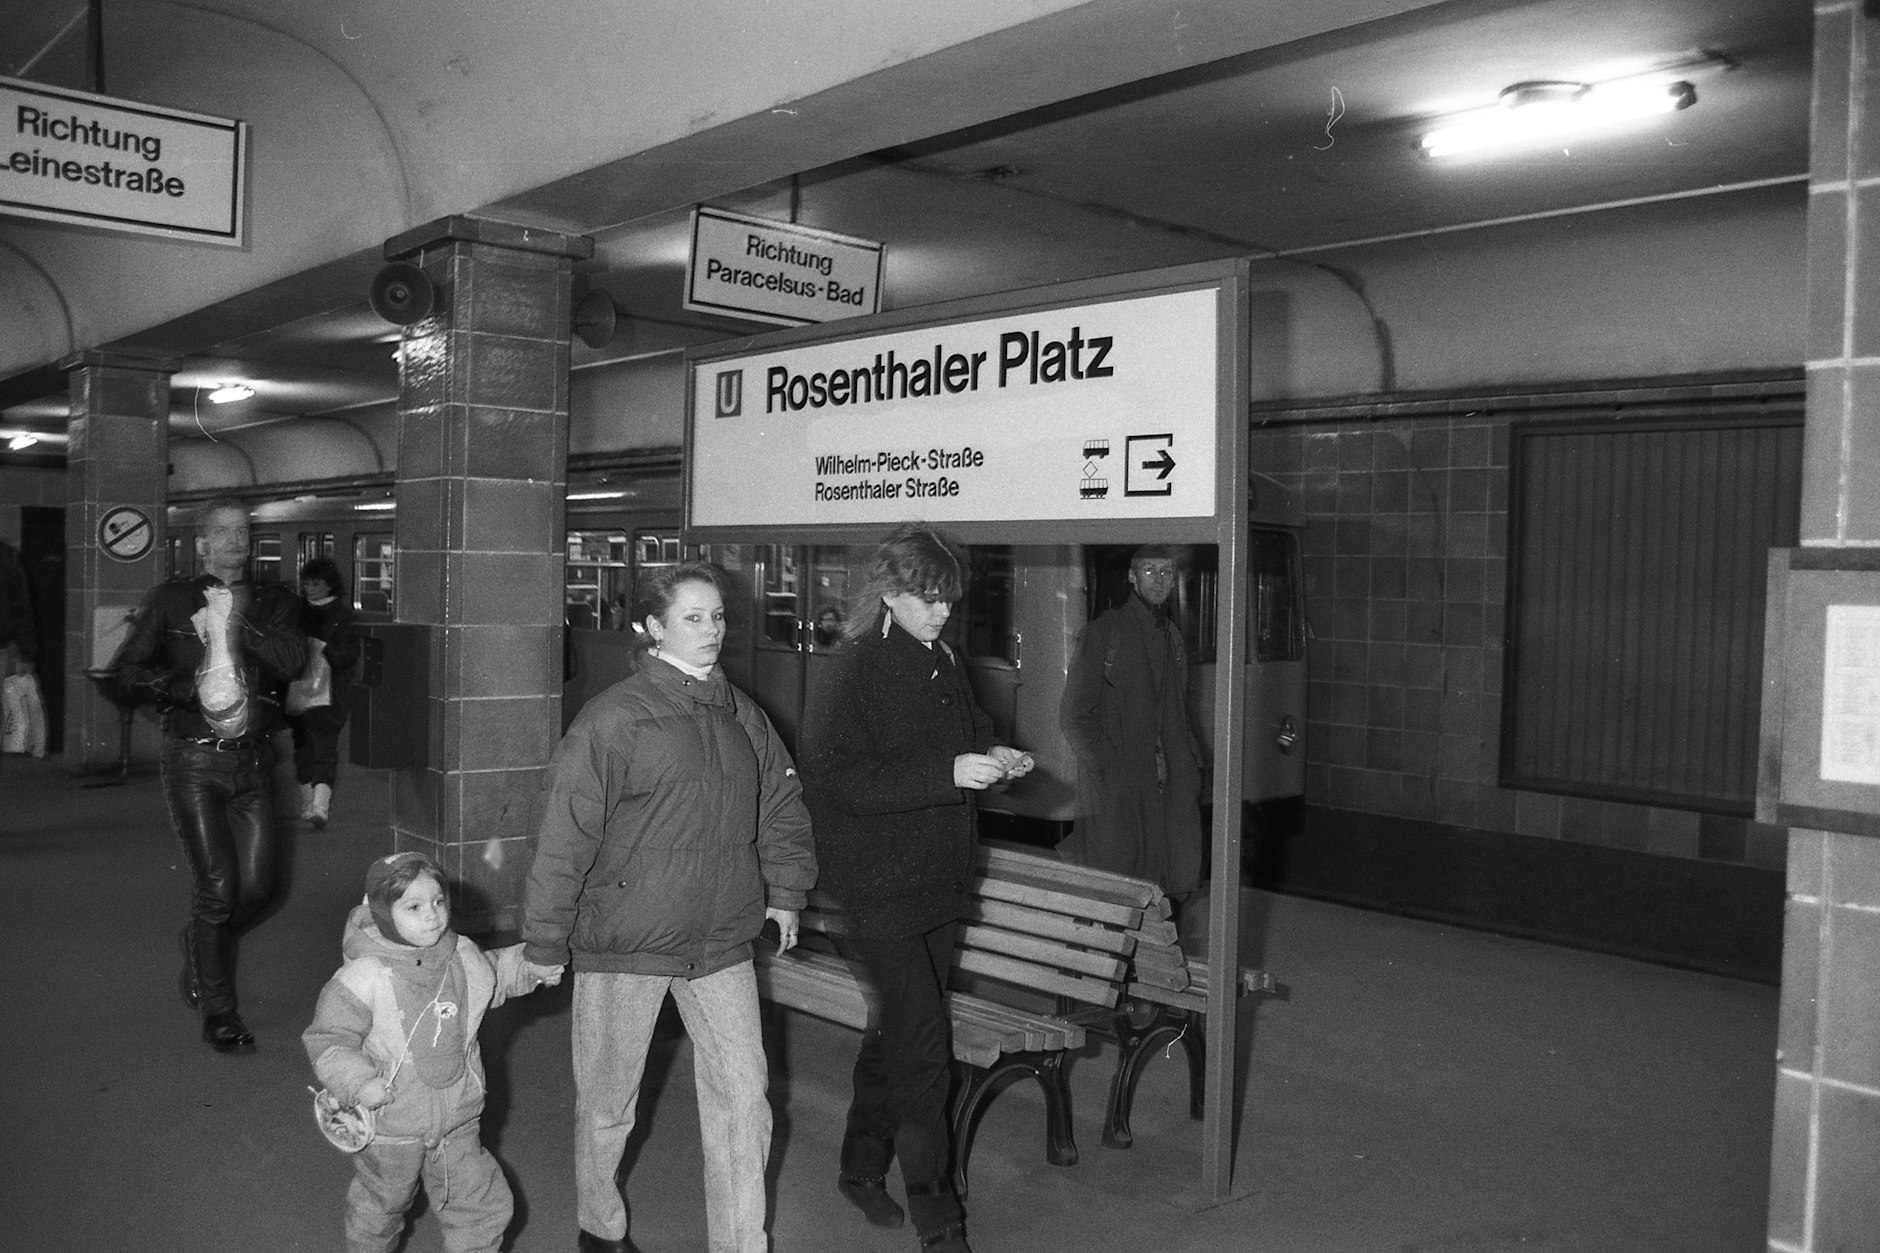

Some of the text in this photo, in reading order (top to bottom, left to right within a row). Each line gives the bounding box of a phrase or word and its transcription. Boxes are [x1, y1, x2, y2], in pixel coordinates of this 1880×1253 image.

[17, 105, 161, 162] Richtung
[747, 234, 833, 275] Richtung
[707, 258, 864, 305] Paracelsus-Bad
[716, 326, 1114, 417] U Rosenthaler Platz
[815, 447, 984, 475] Wilhelm-Pieck-Straße
[815, 477, 960, 502] Rosenthaler Straße
